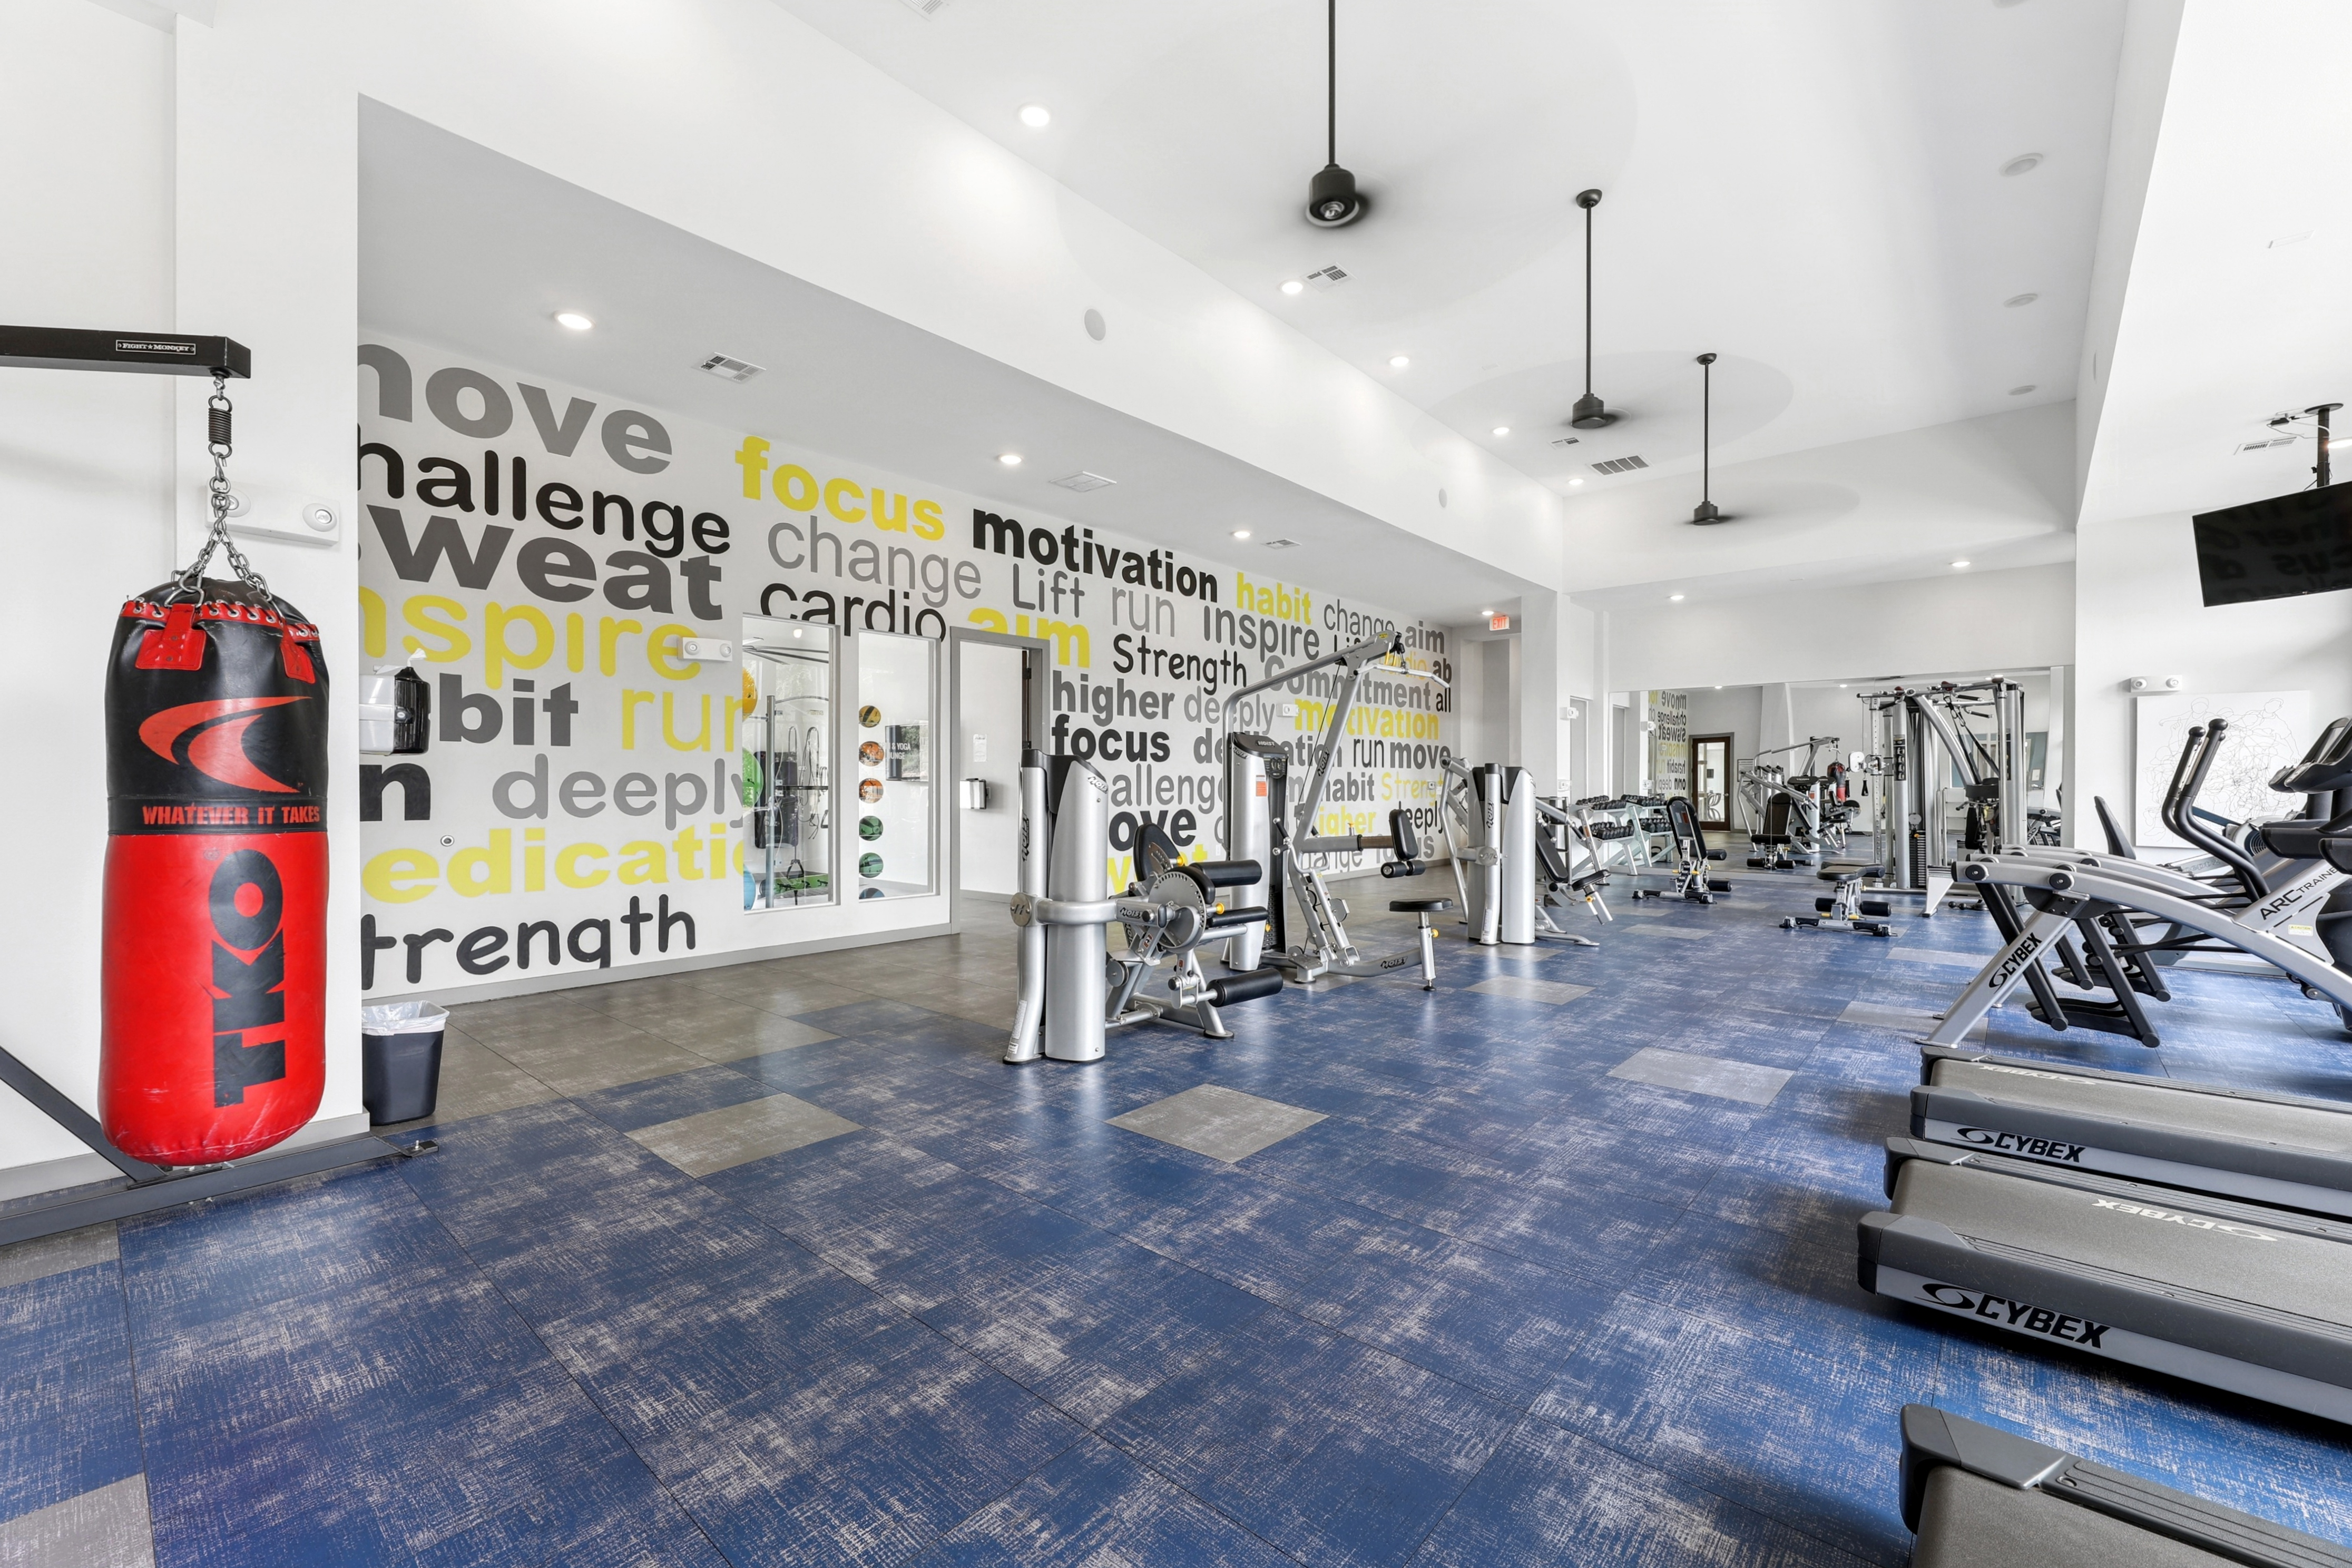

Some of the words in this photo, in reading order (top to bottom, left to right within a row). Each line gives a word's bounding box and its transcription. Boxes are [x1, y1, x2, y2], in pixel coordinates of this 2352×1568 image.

[357, 422, 730, 558] hallenge
[734, 435, 945, 541] focus
[358, 504, 723, 621] weat
[768, 515, 981, 608] change
[973, 508, 1218, 603] motivation
[1013, 563, 1085, 618] Lift
[1112, 587, 1175, 638] run
[1237, 571, 1311, 626] habit
[359, 586, 701, 690] spire
[1204, 605, 1319, 662] inspire
[1405, 620, 1445, 654] aim
[1493, 617, 1507, 630] EXIT
[1113, 633, 1247, 695] Strength
[439, 673, 579, 747] bit
[1053, 670, 1175, 727] higher
[1184, 685, 1275, 736] deply
[1436, 687, 1451, 713] all
[1052, 713, 1170, 762] focus
[1233, 747, 1251, 759] HOIST
[1317, 747, 1330, 777] HOIST
[1353, 739, 1384, 768] run
[1391, 742, 1451, 769] move
[1087, 776, 1108, 794] HOIS
[1111, 763, 1223, 815] alleng
[1381, 771, 1444, 807] Strengt
[142, 803, 249, 825] WHATEVER
[281, 806, 320, 824] TAKES
[1021, 814, 1030, 863] HOIST
[1319, 805, 1376, 837] igher
[362, 823, 743, 904] edicati
[2259, 889, 2302, 920] ARC
[2296, 867, 2338, 894] TRAINE
[361, 894, 696, 991] trength
[1380, 956, 1408, 969] HOIST
[2003, 932, 2043, 981] CYBEX
[208, 849, 286, 1109] TKO
[1978, 1065, 2060, 1080] CYBEX
[1995, 1132, 2086, 1163] CYBEX
[2092, 1198, 2217, 1231] CYBEX
[1975, 1297, 2111, 1349] CYBEX
